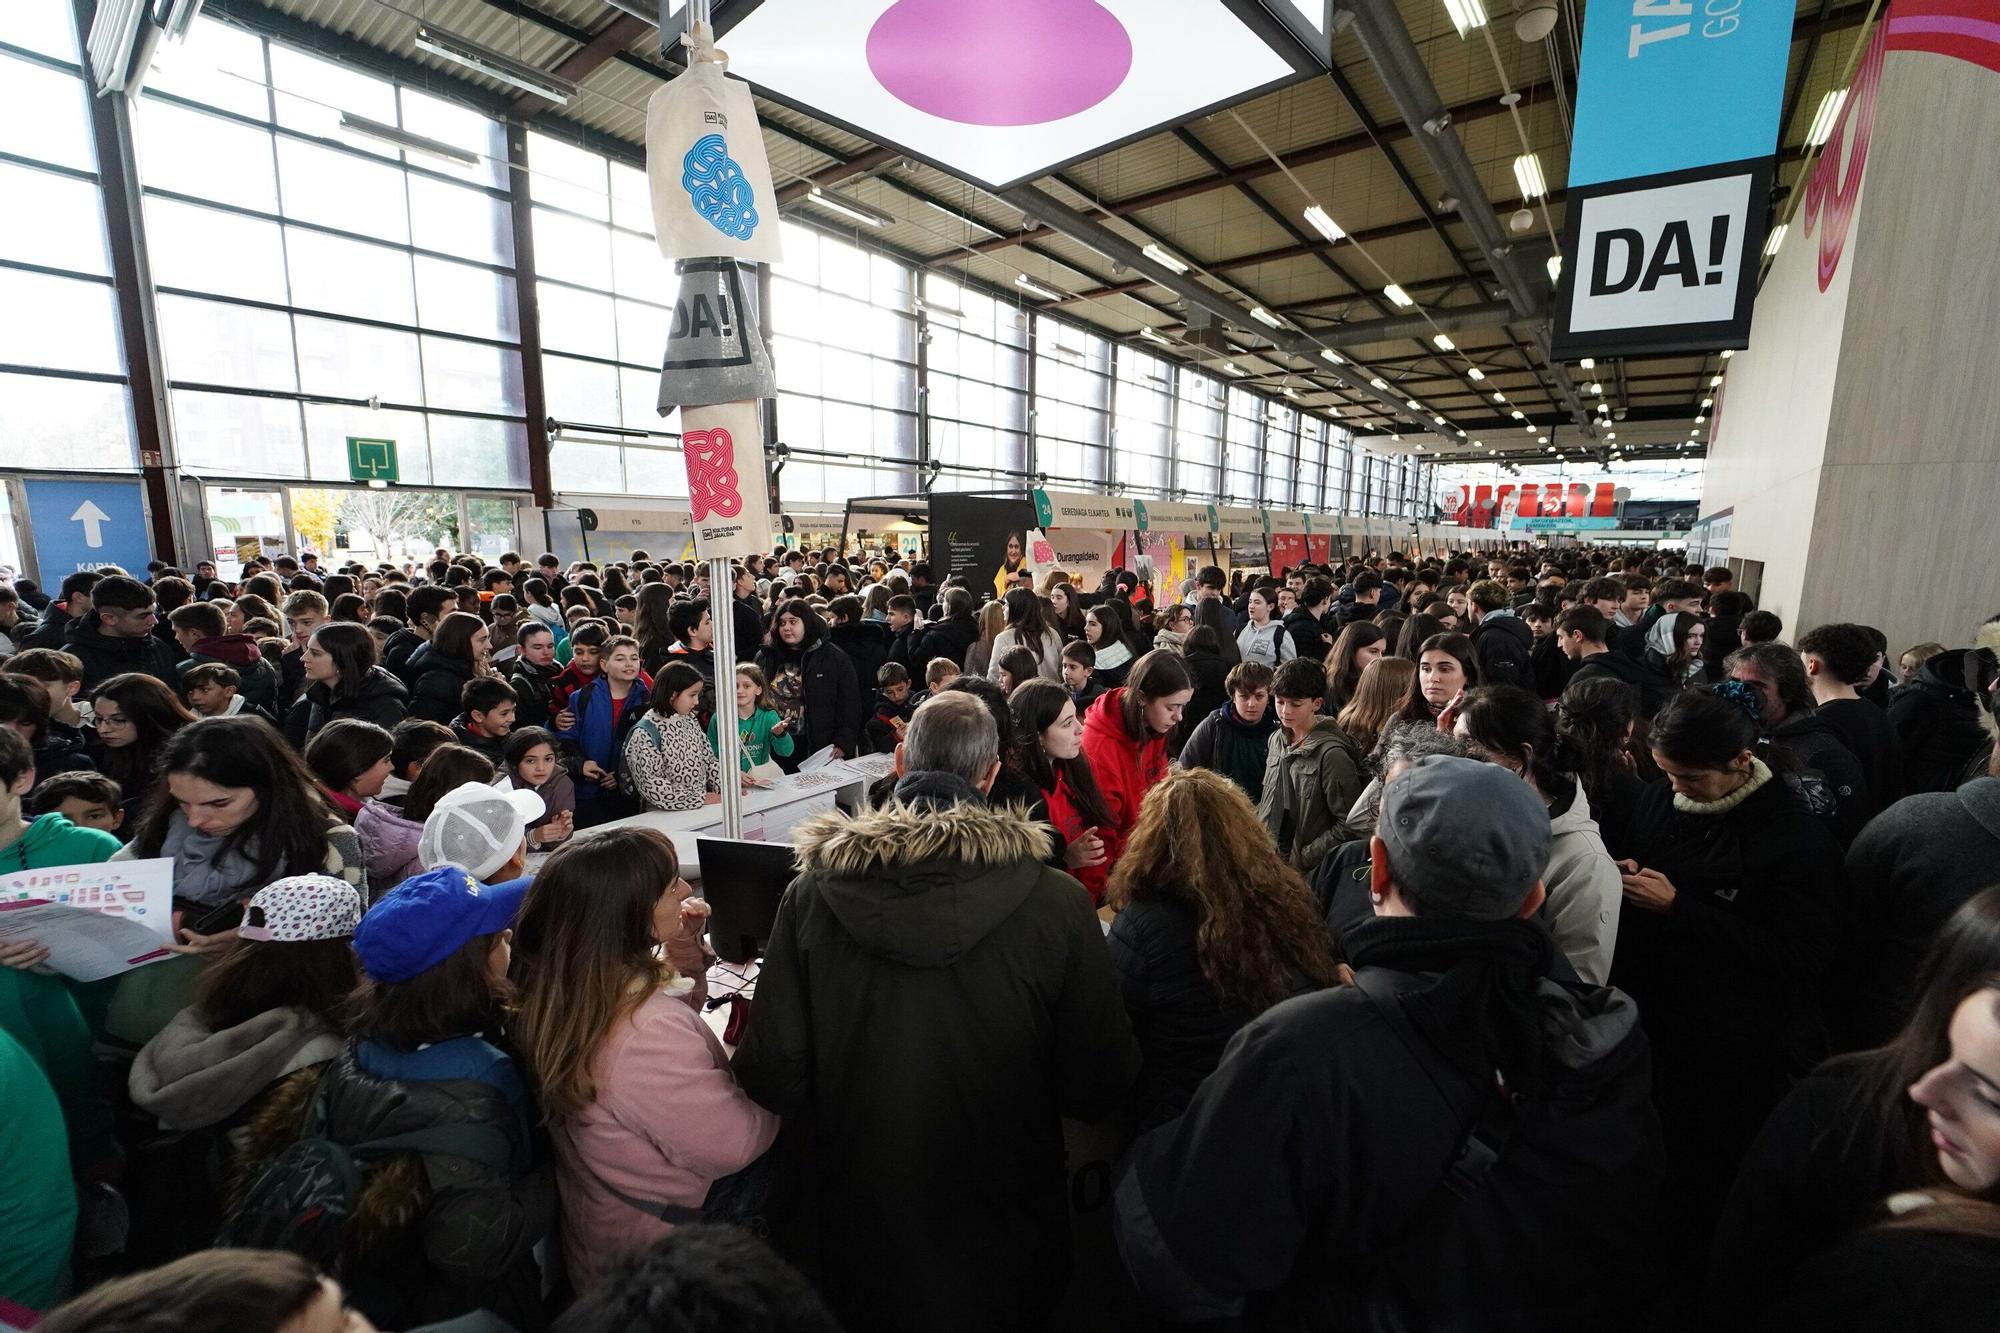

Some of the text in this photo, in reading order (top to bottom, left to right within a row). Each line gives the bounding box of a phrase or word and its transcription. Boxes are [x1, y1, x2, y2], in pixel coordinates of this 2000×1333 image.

[1589, 214, 1731, 298] DA!
[1042, 503, 1051, 515] 24
[712, 525, 743, 533] KULTURAREN
[1056, 551, 1099, 564] Durangaldeko
